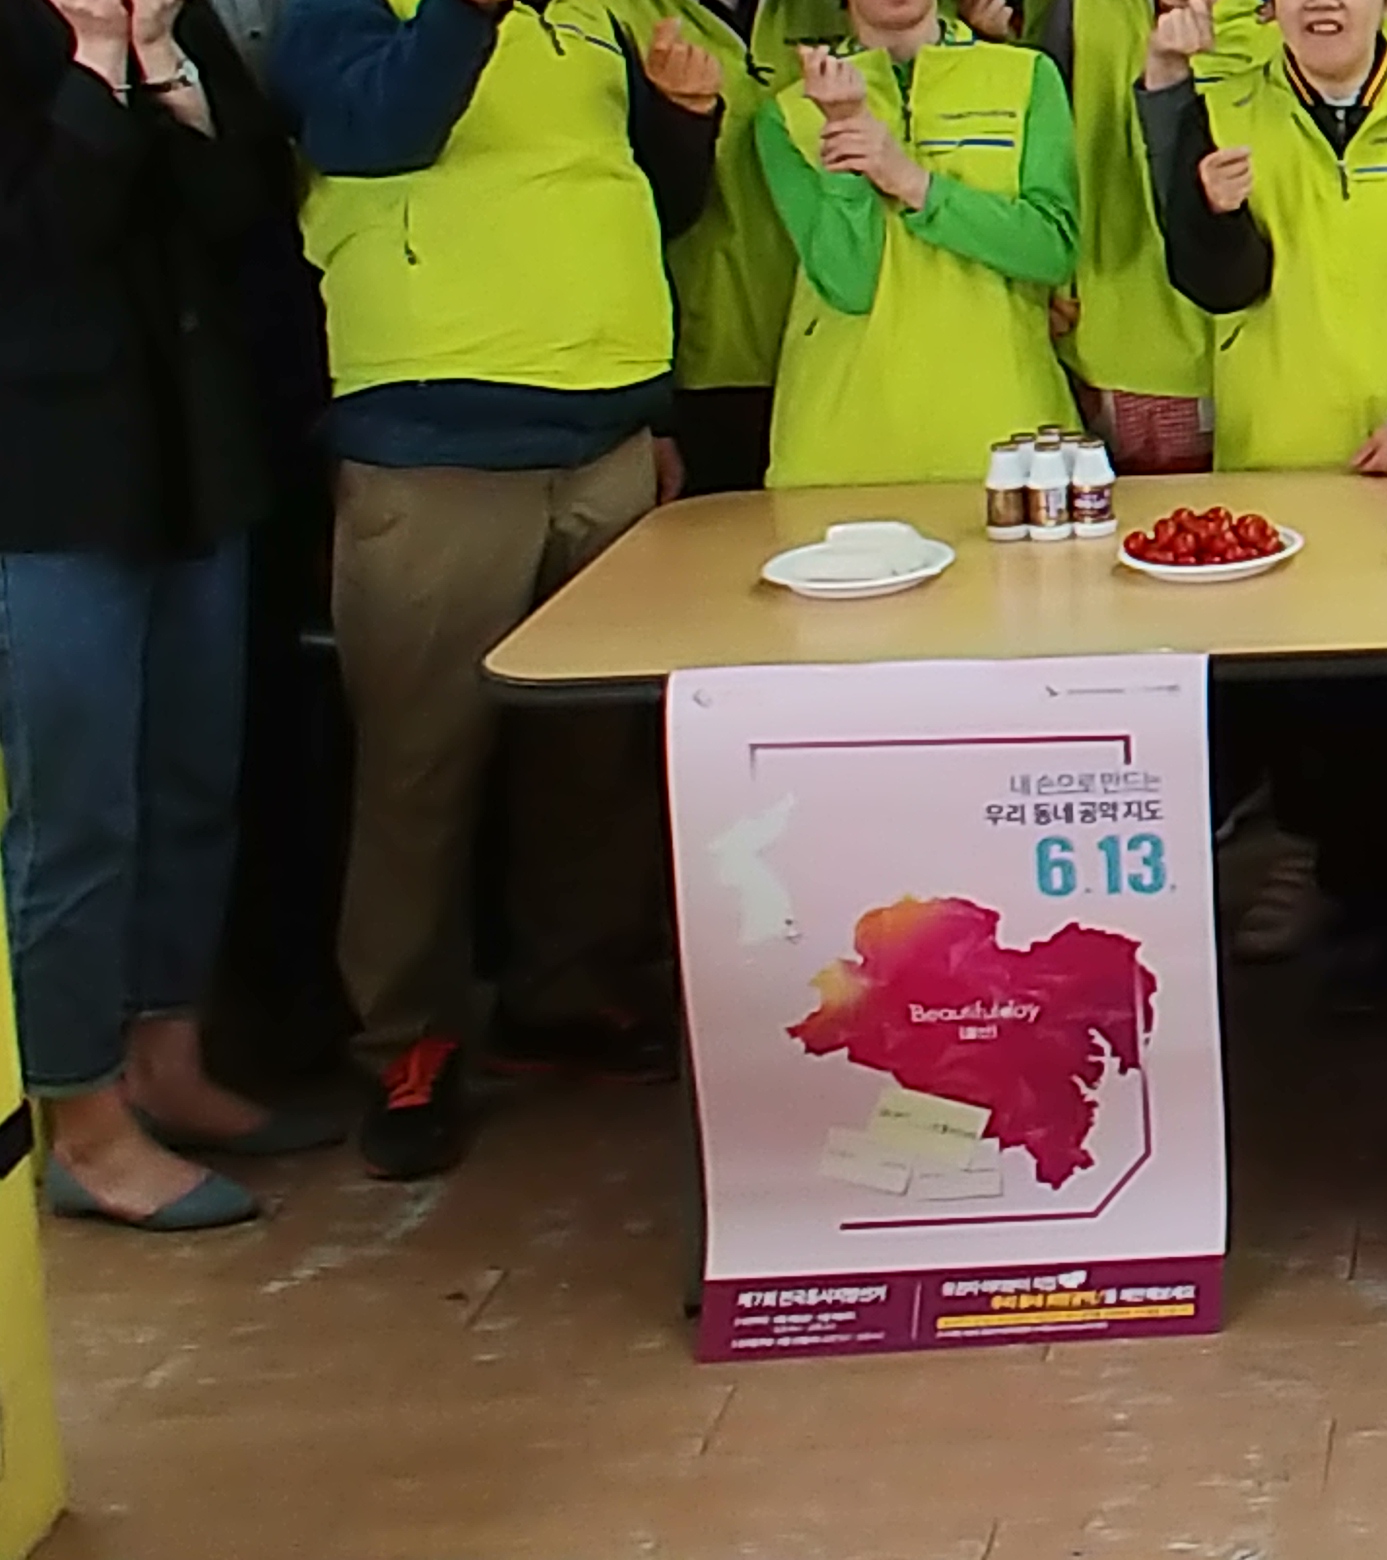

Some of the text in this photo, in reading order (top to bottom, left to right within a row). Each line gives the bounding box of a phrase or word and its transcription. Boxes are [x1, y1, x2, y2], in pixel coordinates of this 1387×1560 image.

[1010, 771, 1161, 796] 내 손으로 만드는
[985, 799, 1164, 826] 우리 동네 공약 지도
